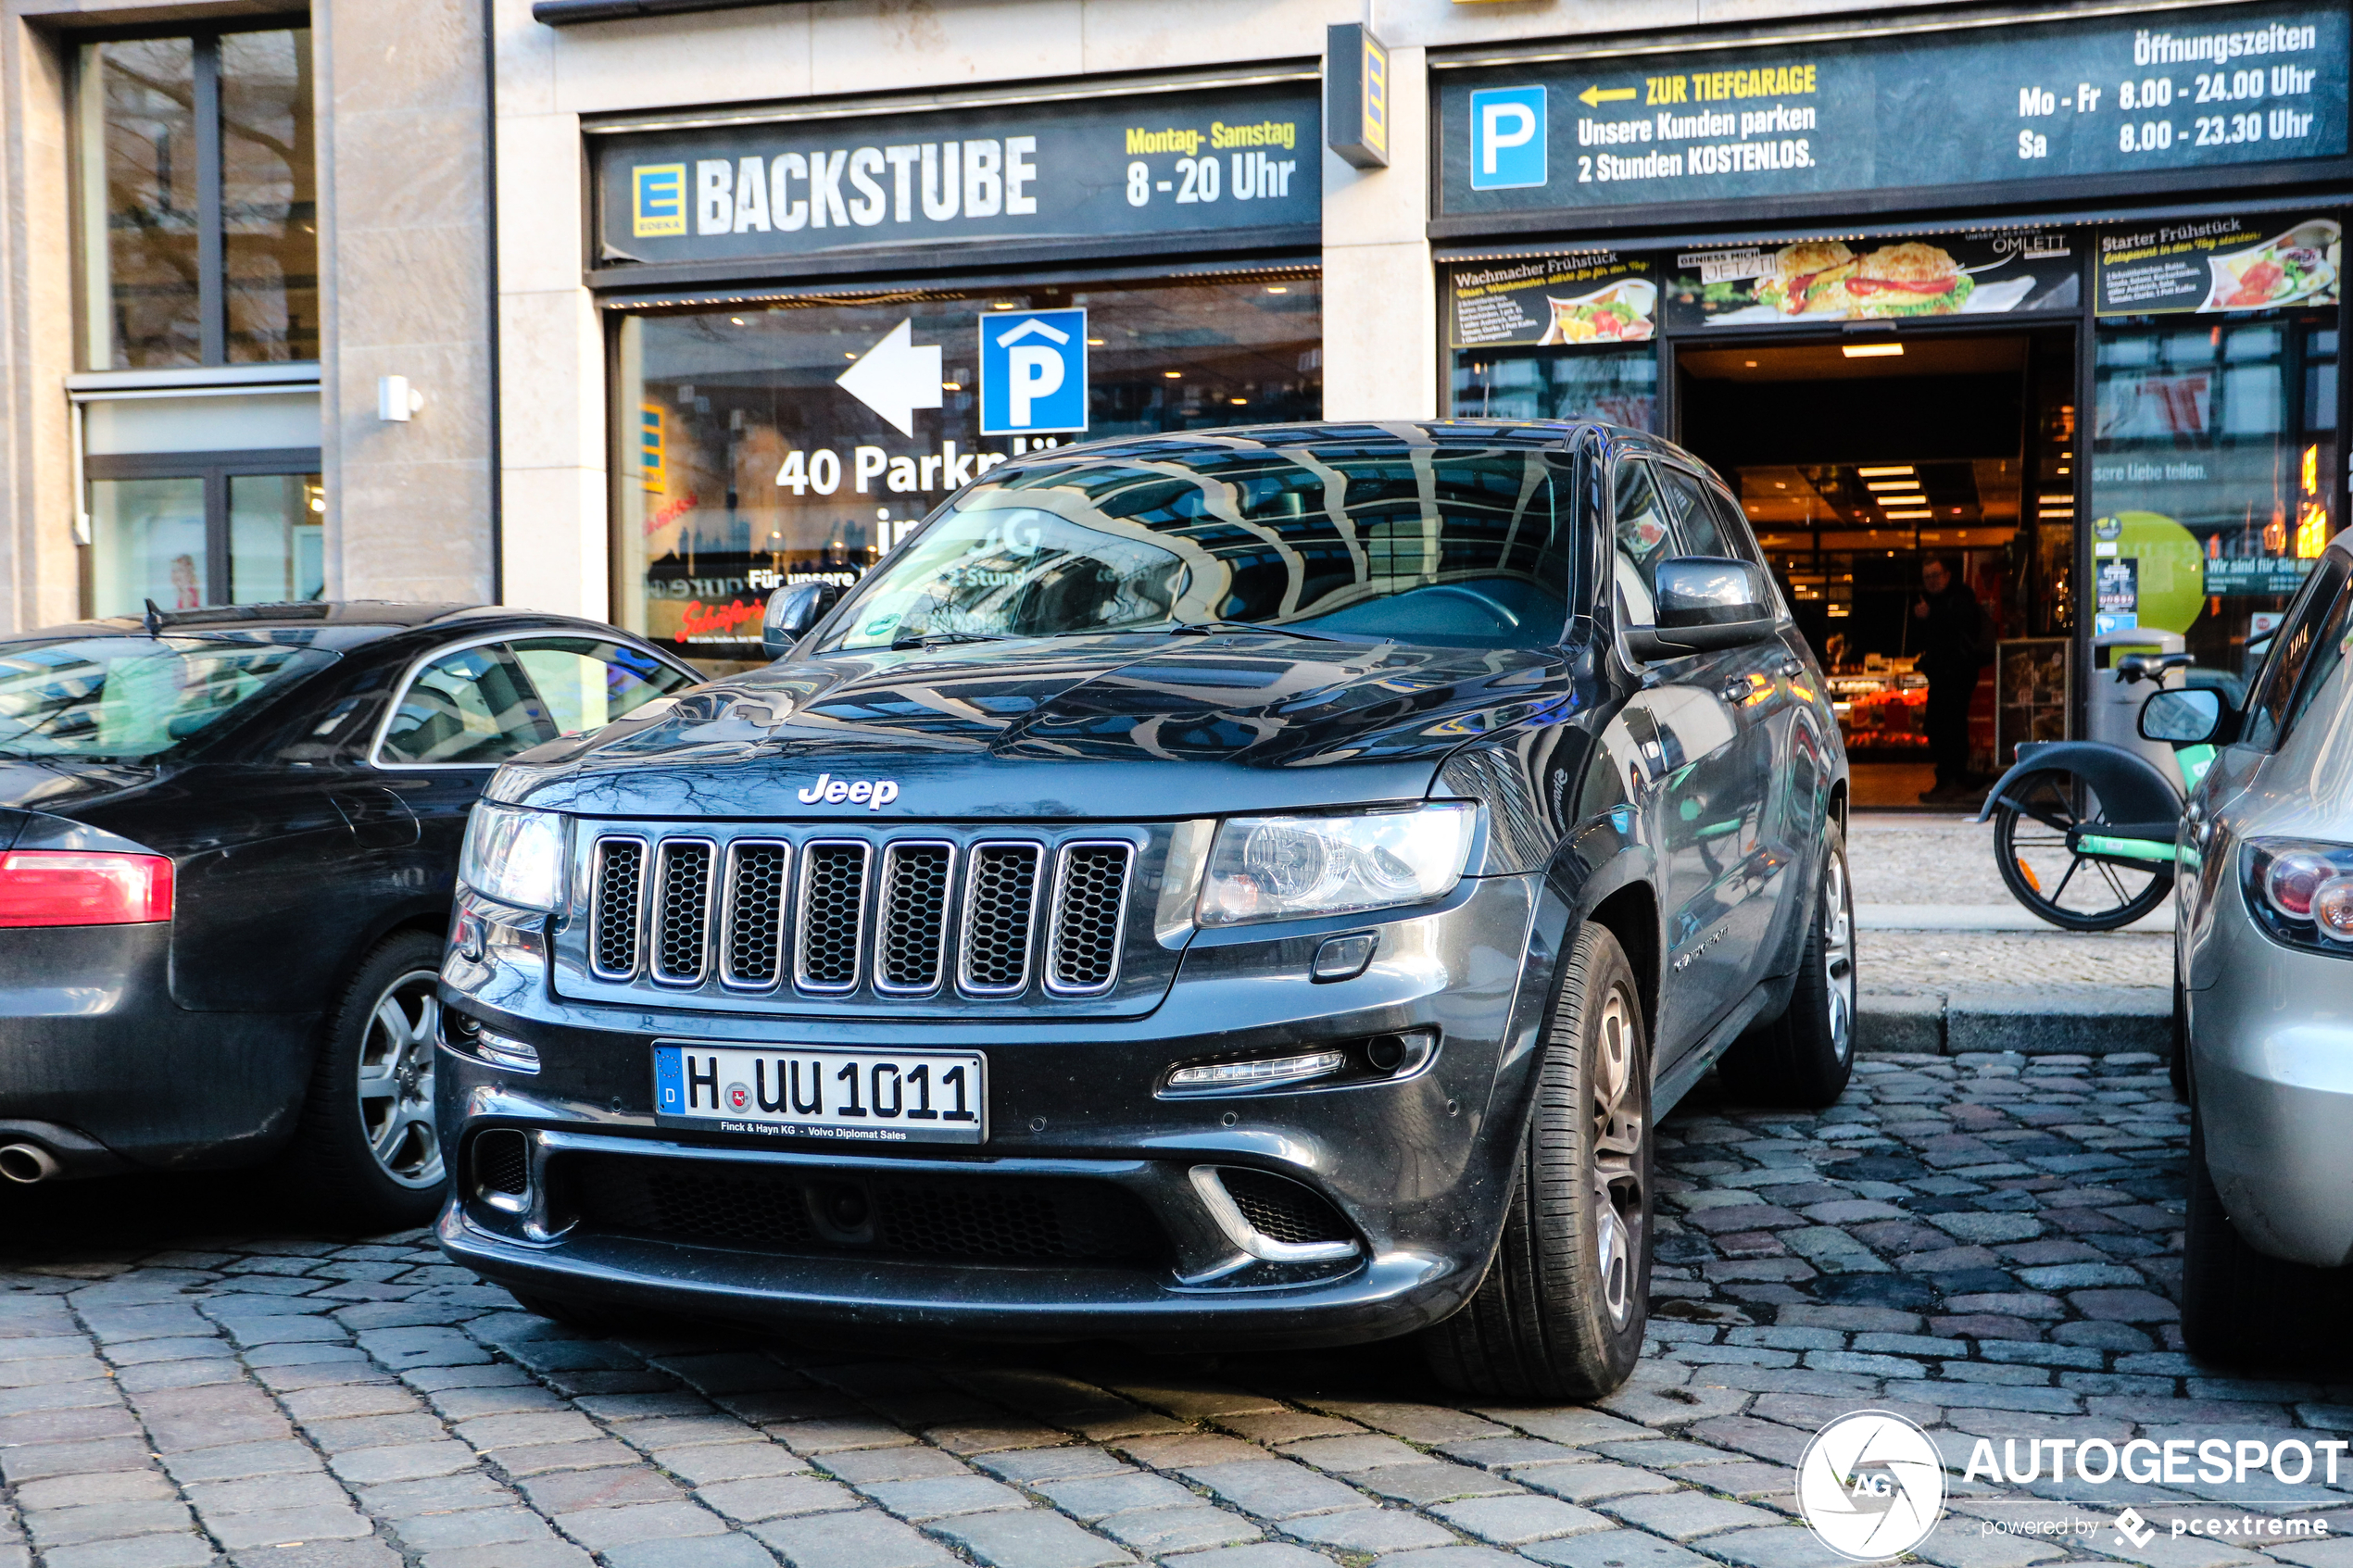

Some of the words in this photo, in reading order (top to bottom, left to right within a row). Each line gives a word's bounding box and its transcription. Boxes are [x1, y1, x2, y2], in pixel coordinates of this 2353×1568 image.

[2134, 22, 2316, 68] Öffnungszeiten
[1645, 74, 1688, 106] ZUR
[1692, 65, 1816, 101] TIEFGARAGE
[2020, 86, 2055, 118] Mo
[2078, 82, 2101, 113] Fr
[2120, 78, 2171, 111] 8.00
[2196, 70, 2266, 104] 24.00
[2271, 65, 2316, 98] Uhr
[1211, 120, 1296, 150] Samstag
[1482, 102, 1536, 174] P
[1579, 118, 1653, 146] Unsere
[1657, 108, 1736, 141] Kunden
[1741, 103, 1816, 141] parken
[2019, 129, 2047, 159] Sa
[2120, 120, 2171, 153] 8.00
[2196, 113, 2263, 146] 23.30
[2269, 109, 2313, 141] Uhr
[1126, 161, 1150, 207] 8
[1176, 157, 1220, 204] 20
[1231, 151, 1296, 200] Uhr
[1578, 155, 1592, 183] 2
[1597, 149, 1682, 182] Stunden
[1688, 138, 1816, 175] KOSTENLOS.
[697, 135, 1037, 236] BACKSTUBE
[1992, 233, 2067, 254] OMLETT
[2103, 232, 2156, 252] Starter
[2159, 216, 2241, 244] Frühstück
[1454, 263, 1545, 288] Wachmacher
[1547, 251, 1618, 274] Frühstück
[1680, 254, 1727, 265] GENIESS
[1730, 251, 1758, 260] MICH
[1009, 345, 1065, 427] P
[775, 448, 841, 496] 40
[2127, 461, 2163, 482] Liebe
[748, 570, 784, 590] Für
[786, 571, 855, 588] unsere
[2208, 558, 2229, 573] Wir
[2230, 557, 2256, 573] sind
[2258, 557, 2276, 573] für
[2277, 556, 2296, 573] Sie
[798, 772, 900, 811] Jeep
[665, 1087, 676, 1103] D
[687, 1055, 719, 1110] H
[755, 1058, 824, 1115] UU
[837, 1061, 975, 1122] 1011
[721, 1121, 745, 1132] Finck
[747, 1123, 754, 1133] &
[756, 1123, 780, 1135] Hayn
[781, 1124, 796, 1135] KG
[808, 1126, 833, 1137] Volvo
[836, 1127, 878, 1141] Diplomat
[880, 1129, 907, 1140] Sales
